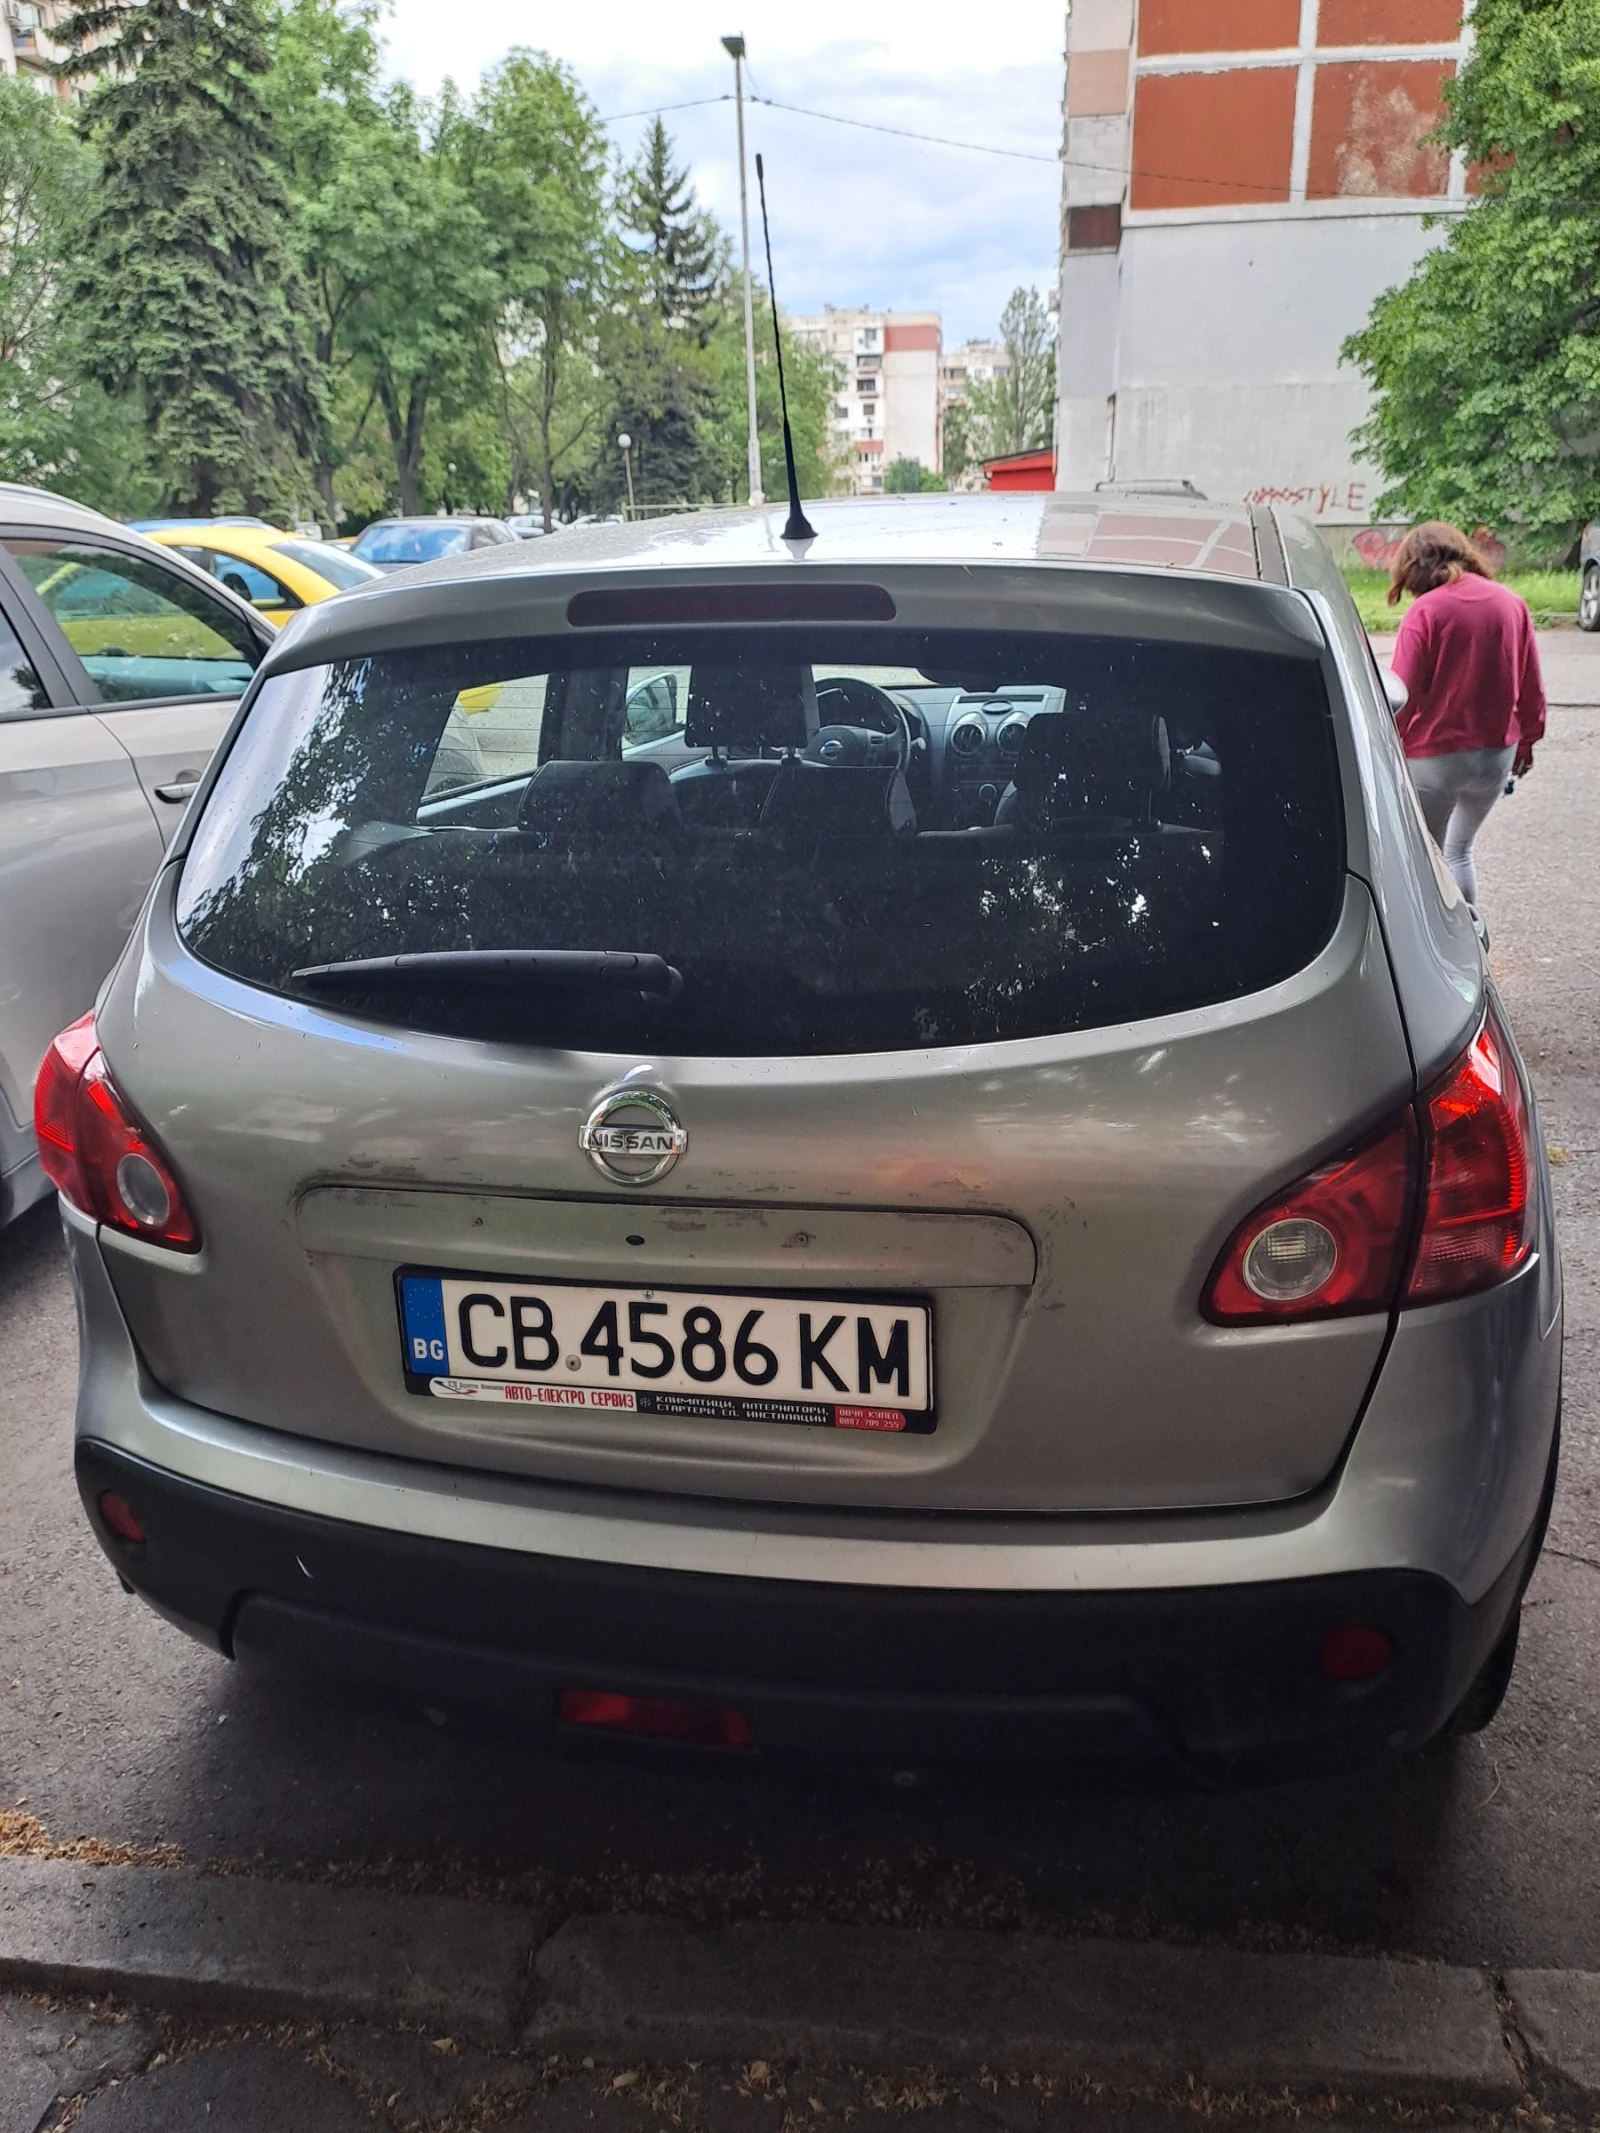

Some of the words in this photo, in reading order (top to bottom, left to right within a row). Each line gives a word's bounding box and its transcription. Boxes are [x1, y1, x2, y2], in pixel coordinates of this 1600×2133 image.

[588, 1130, 673, 1150] NISSAN
[413, 1337, 444, 1360] BG
[580, 1300, 778, 1386] 4586
[505, 1386, 585, 1405] АВТО-ЕЛЕКТРО
[591, 1391, 634, 1408] СЕРВИЗ
[657, 1404, 715, 1415] СТАРТЕРИ
[746, 1410, 826, 1423] ИНСТАЛАЦИИ
[839, 1409, 863, 1417] ОВЧА
[868, 1411, 898, 1420] КУПЕЛ
[839, 1417, 860, 1426] 0887
[884, 1420, 899, 1428] 255
